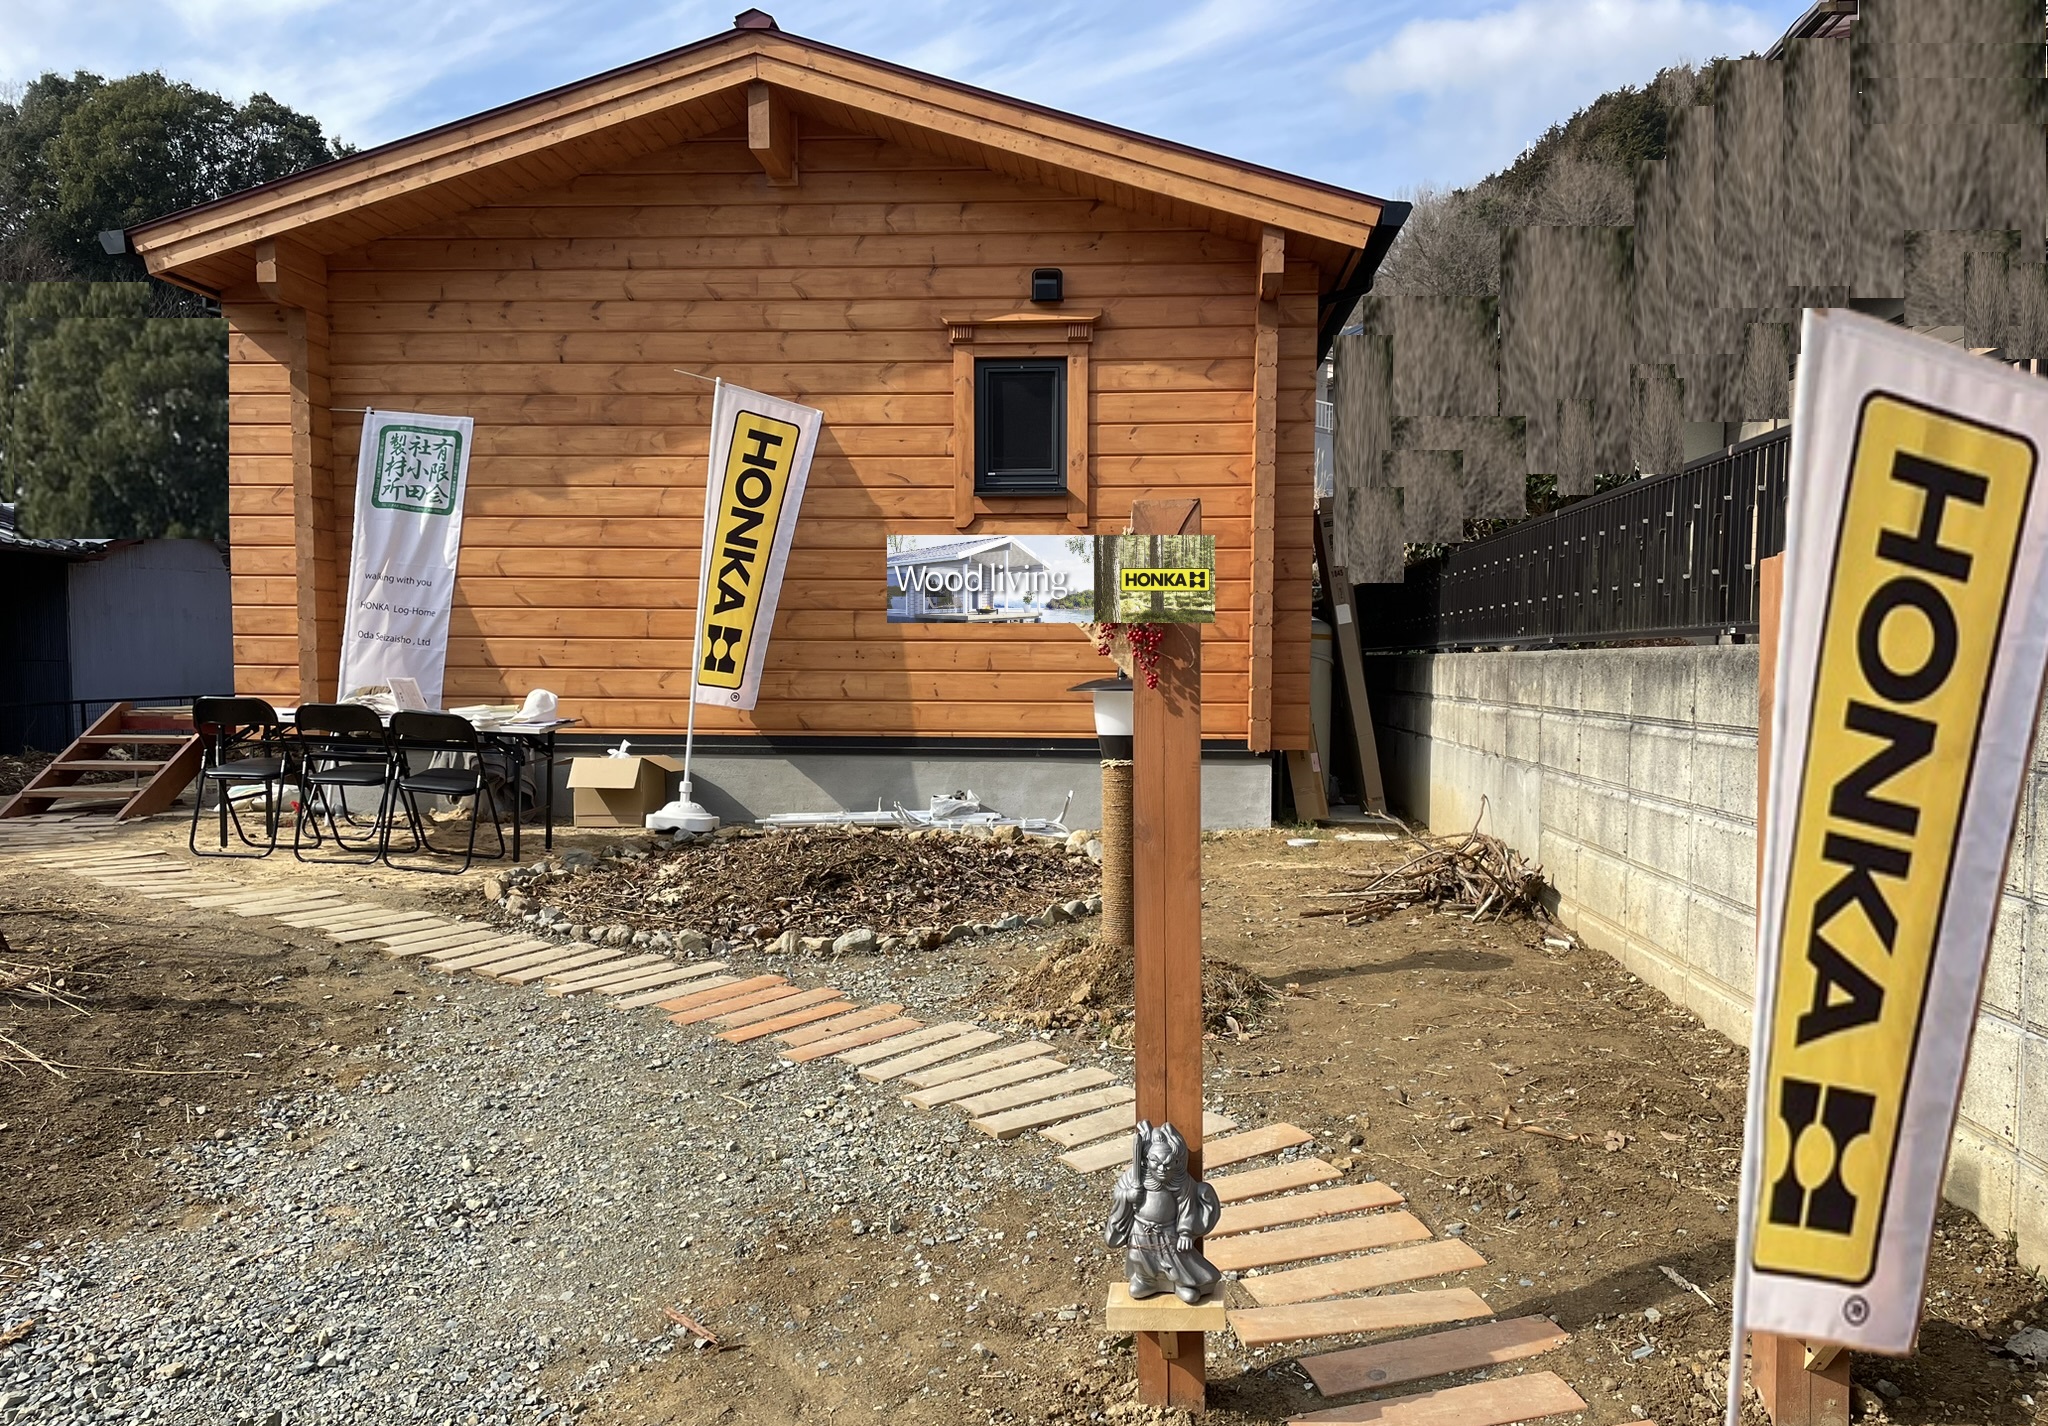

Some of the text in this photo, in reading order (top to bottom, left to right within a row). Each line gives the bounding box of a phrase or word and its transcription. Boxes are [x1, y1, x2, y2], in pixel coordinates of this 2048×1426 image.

[382, 432, 407, 501] 製材所
[405, 435, 432, 501] 社小田
[426, 438, 453, 504] 有限会
[713, 428, 784, 615] HONKA
[396, 576, 415, 585] with
[416, 579, 432, 587] you
[895, 563, 1074, 599] Wood living.
[1125, 572, 1187, 587] HONKA
[360, 601, 436, 617] HONKA Log-Home
[358, 630, 374, 640] Oda
[417, 638, 431, 646] Ltd
[1795, 450, 1989, 1047] HONKA
